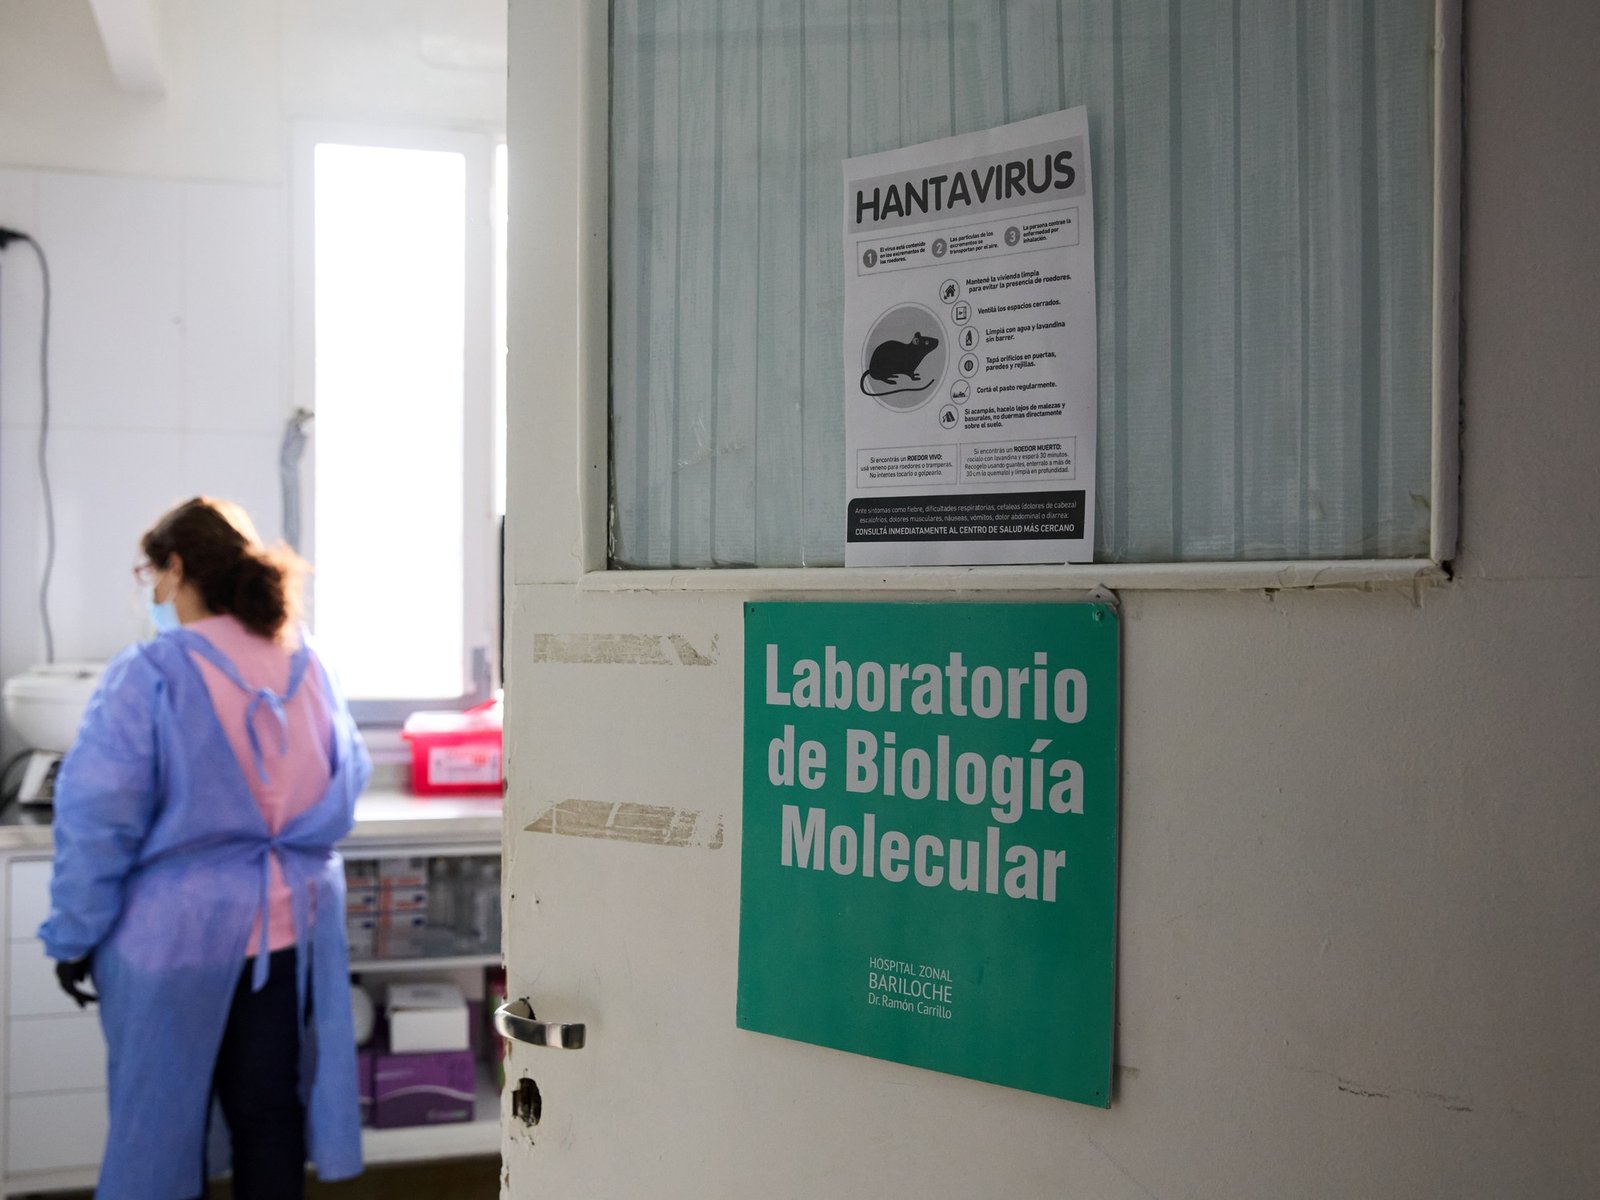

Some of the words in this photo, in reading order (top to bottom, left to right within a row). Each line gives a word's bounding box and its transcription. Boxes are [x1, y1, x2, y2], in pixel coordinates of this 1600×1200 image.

[856, 151, 1075, 224] HANTAVIRUS
[1029, 222, 1047, 230] persona
[1048, 219, 1065, 227] contrae
[1010, 231, 1016, 242] 3
[1023, 229, 1050, 237] enfermedad
[936, 243, 942, 253] 2
[950, 246, 975, 254] transportan
[868, 253, 872, 264] 1
[966, 276, 989, 285] Mantené
[997, 273, 1020, 281] vivienda
[1021, 270, 1039, 278] limpia
[969, 285, 981, 293] para
[983, 283, 998, 291] evitar
[1006, 279, 1033, 288] presencia
[1043, 274, 1071, 282] roedores.
[1007, 302, 1031, 311] espacios
[1033, 299, 1061, 307] cerrados.
[986, 327, 1004, 335] Limpiá
[1017, 325, 1030, 333] agua
[1036, 321, 1065, 329] lavandina
[986, 356, 999, 364] Tapá
[1000, 354, 1023, 362] orificios
[986, 363, 1009, 372] paredes
[1015, 361, 1035, 369] rejillas.
[999, 385, 1015, 393] pasto
[1016, 382, 1057, 391] regularmente.
[997, 405, 1015, 413] hacelo
[1026, 410, 1062, 418] directamente
[1038, 466, 1069, 474] profundidad.
[957, 503, 996, 512] respiratorias,
[855, 526, 887, 535] CONSULTÁ
[888, 527, 947, 535] INMEDIATAMENTE
[1024, 523, 1039, 532] MÁS
[1040, 524, 1074, 532] CERCANO
[766, 644, 1088, 724] Laboratorio
[768, 724, 827, 790] de
[846, 728, 1084, 824] Biología
[781, 804, 1066, 902] Molecular
[869, 957, 916, 976] HOSPITAL
[919, 965, 952, 982] ZONAL
[869, 972, 952, 1003] BARILOCHE
[869, 992, 880, 1005] Dr.
[882, 995, 914, 1012] Ramón
[917, 1002, 952, 1019] Carrillo
